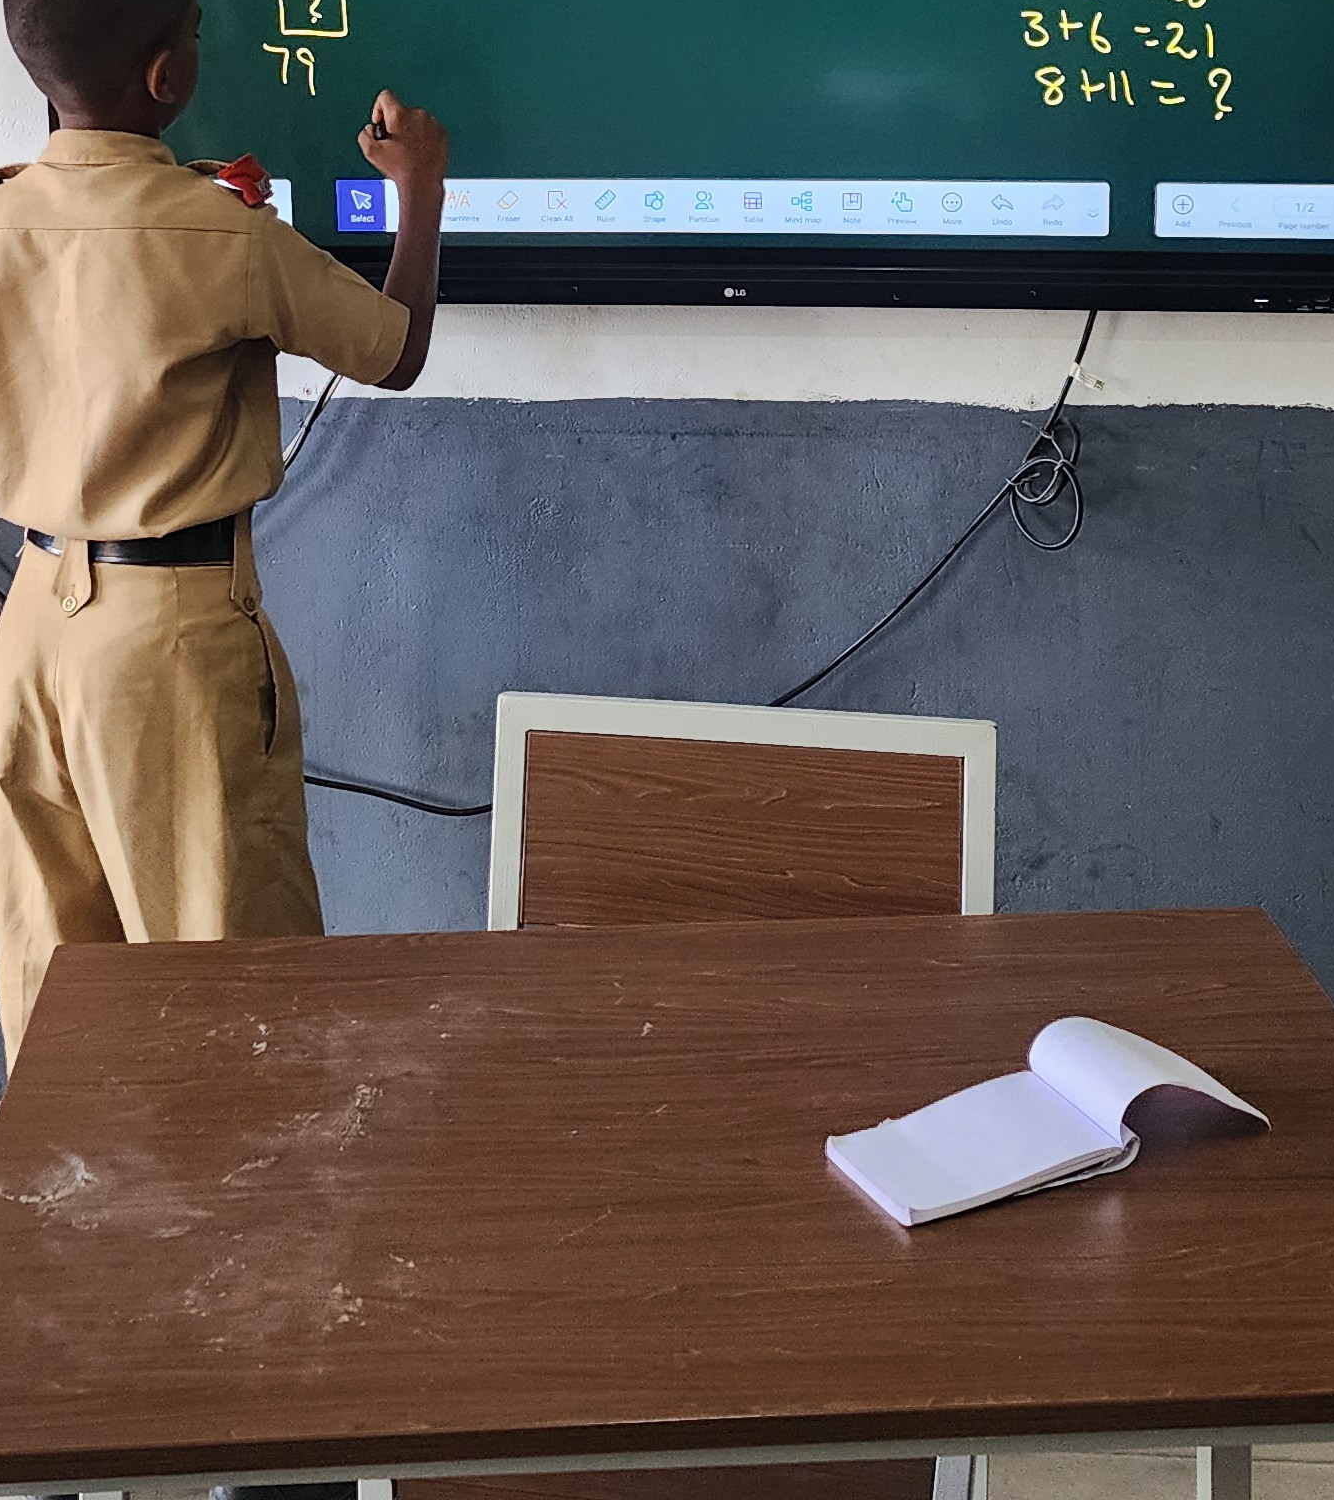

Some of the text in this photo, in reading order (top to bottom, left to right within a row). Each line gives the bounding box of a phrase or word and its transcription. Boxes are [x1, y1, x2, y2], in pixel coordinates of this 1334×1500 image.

[1295, 202, 1315, 213] 1/2
[443, 214, 480, 223] martWrite
[496, 214, 521, 223] Eraser
[541, 214, 562, 223] Clean
[596, 214, 616, 223] Ruler
[643, 215, 667, 224] Shape
[688, 215, 720, 223] Partition
[744, 215, 764, 224] Table
[784, 215, 804, 224] Mind
[843, 216, 862, 225] Note
[887, 216, 918, 225] Preview
[992, 217, 1013, 226] Undo
[1043, 218, 1063, 226] Redo
[1174, 220, 1191, 228] Add
[1218, 220, 1253, 229] Previous
[1278, 222, 1330, 231] Page number
